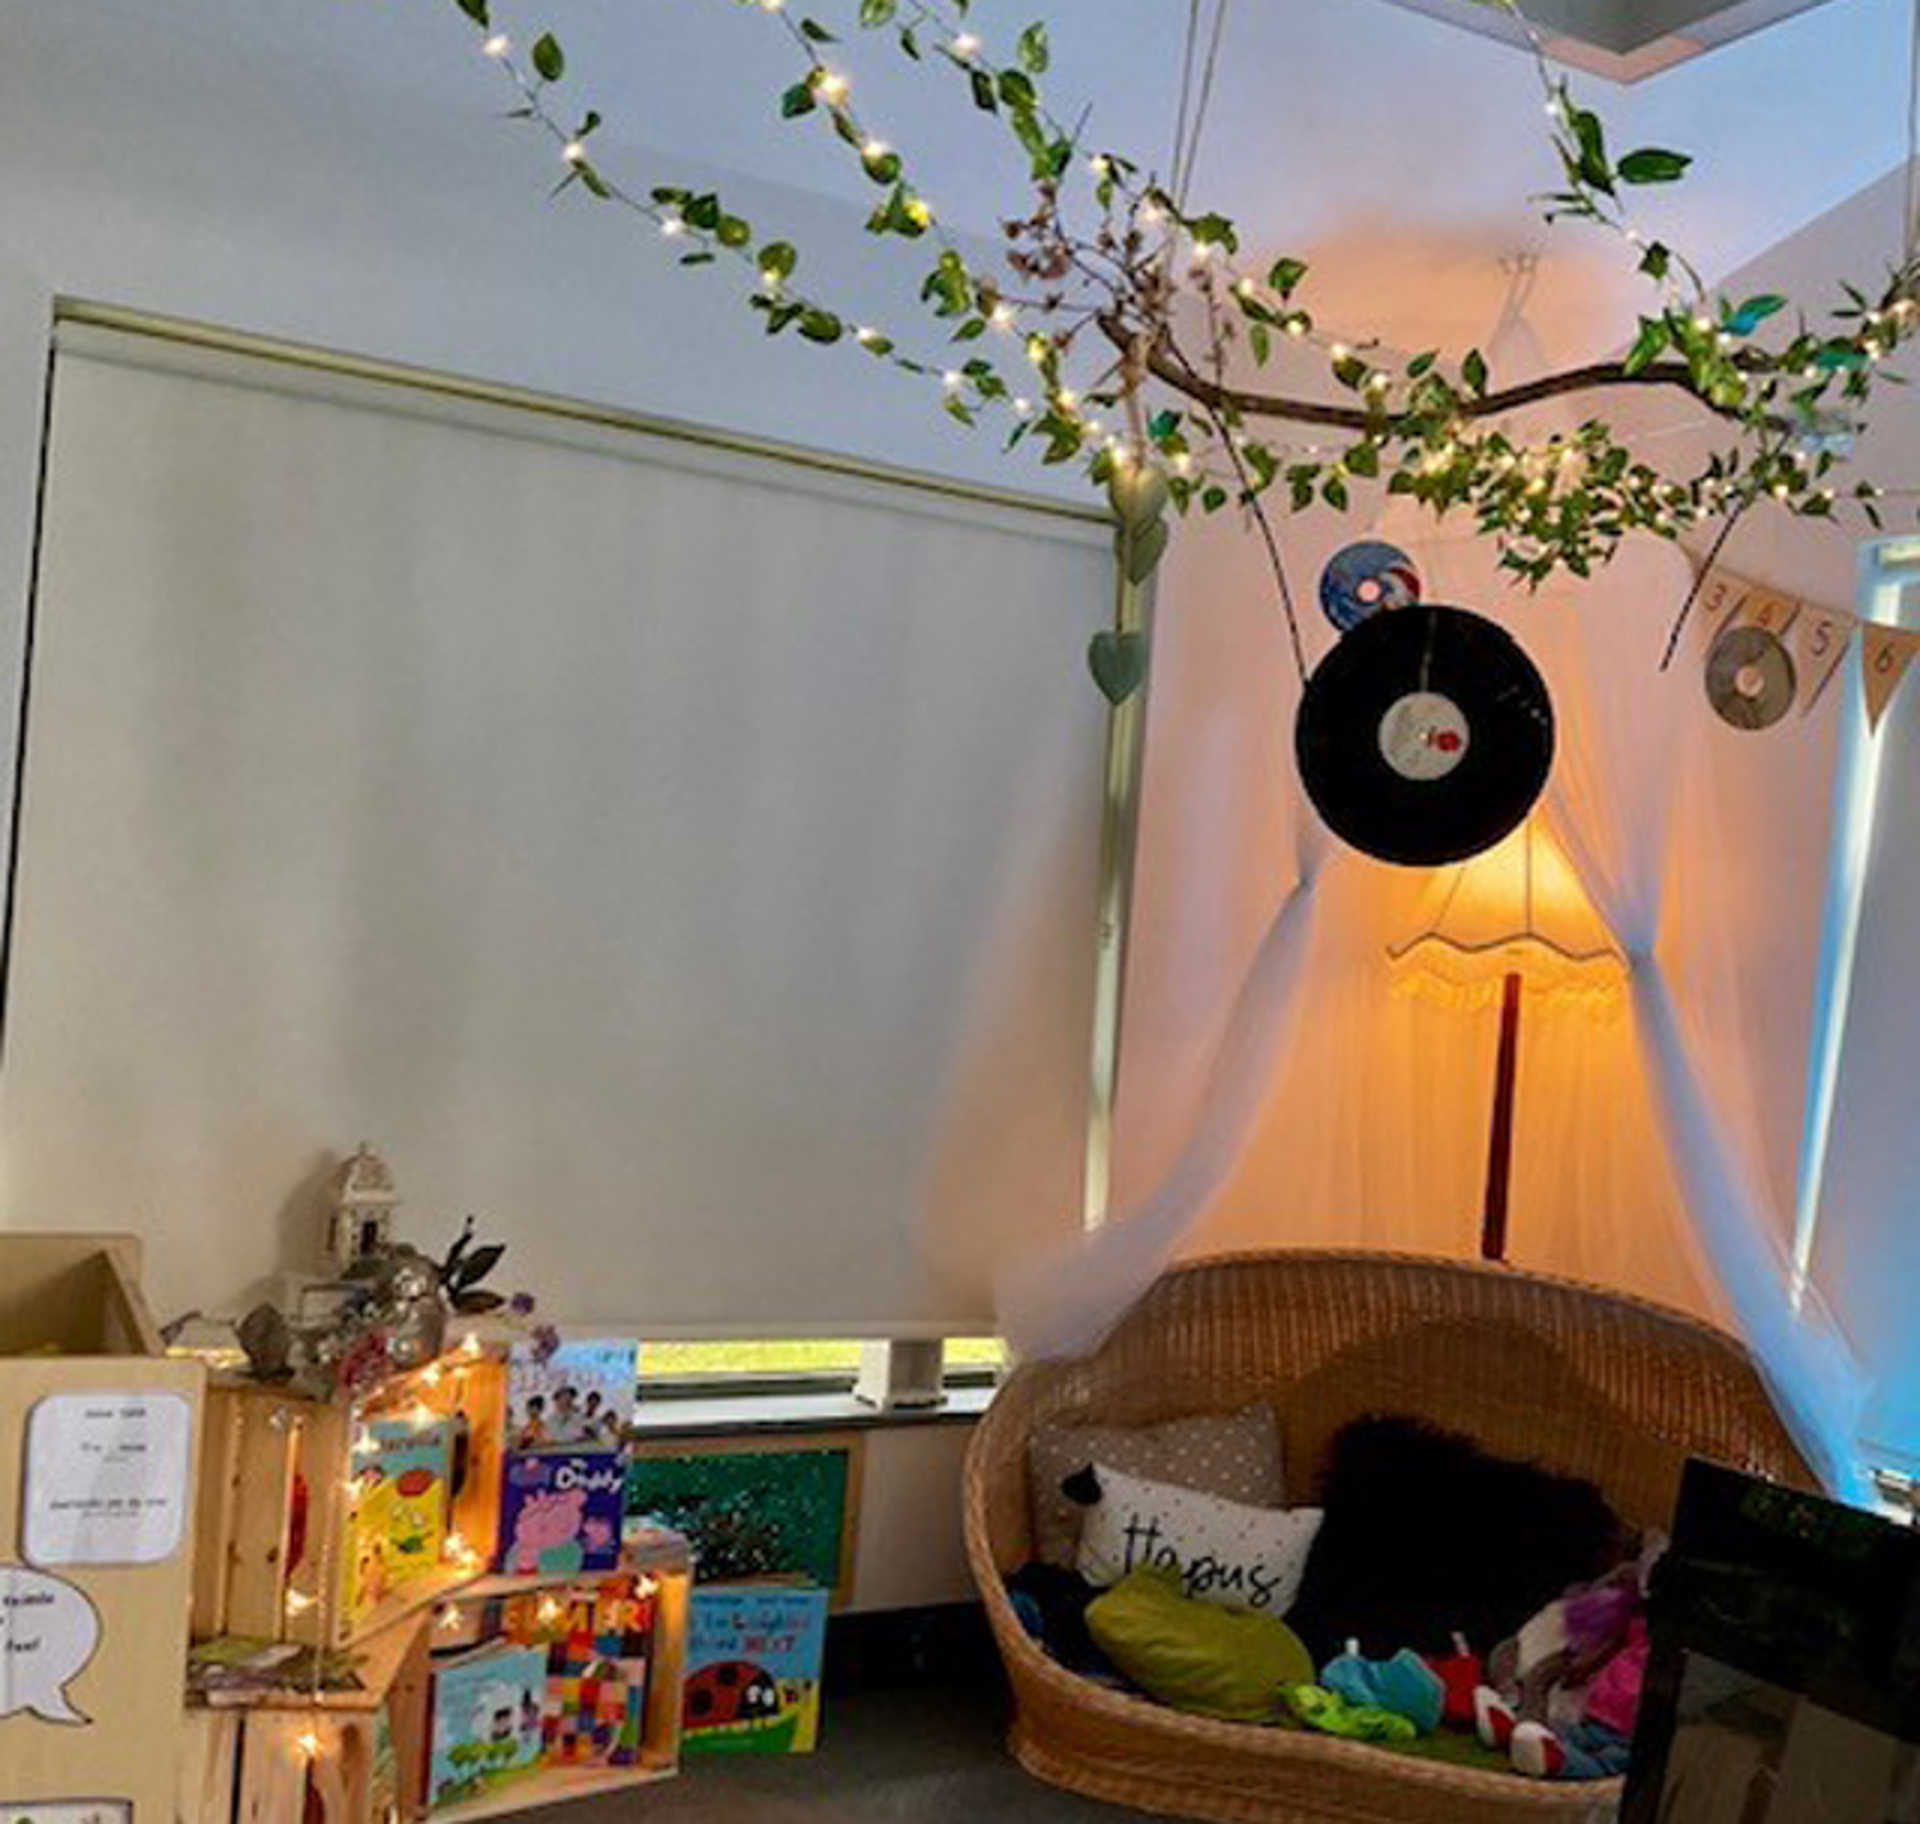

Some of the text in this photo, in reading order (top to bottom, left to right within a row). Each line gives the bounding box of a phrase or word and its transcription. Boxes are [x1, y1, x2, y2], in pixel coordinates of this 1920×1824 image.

[1704, 583, 1727, 613] 3
[1811, 619, 1833, 657] 5
[1874, 641, 1894, 674] 6
[1122, 1512, 1282, 1609] Hapus
